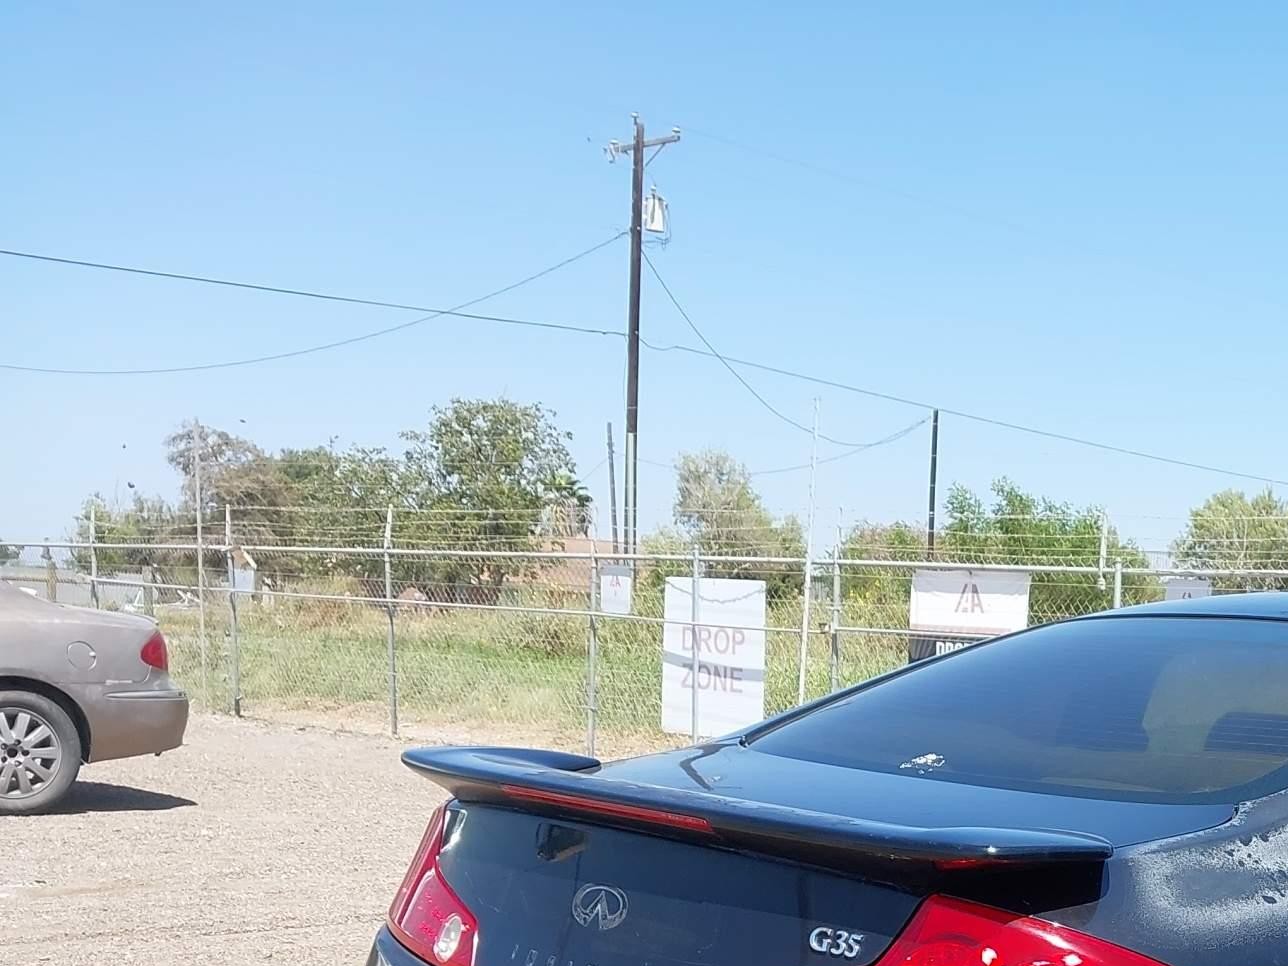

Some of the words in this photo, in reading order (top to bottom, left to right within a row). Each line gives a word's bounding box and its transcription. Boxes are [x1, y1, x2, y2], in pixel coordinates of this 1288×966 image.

[681, 625, 746, 656] DROP
[680, 662, 744, 694] ZONE
[808, 926, 865, 959] G35
